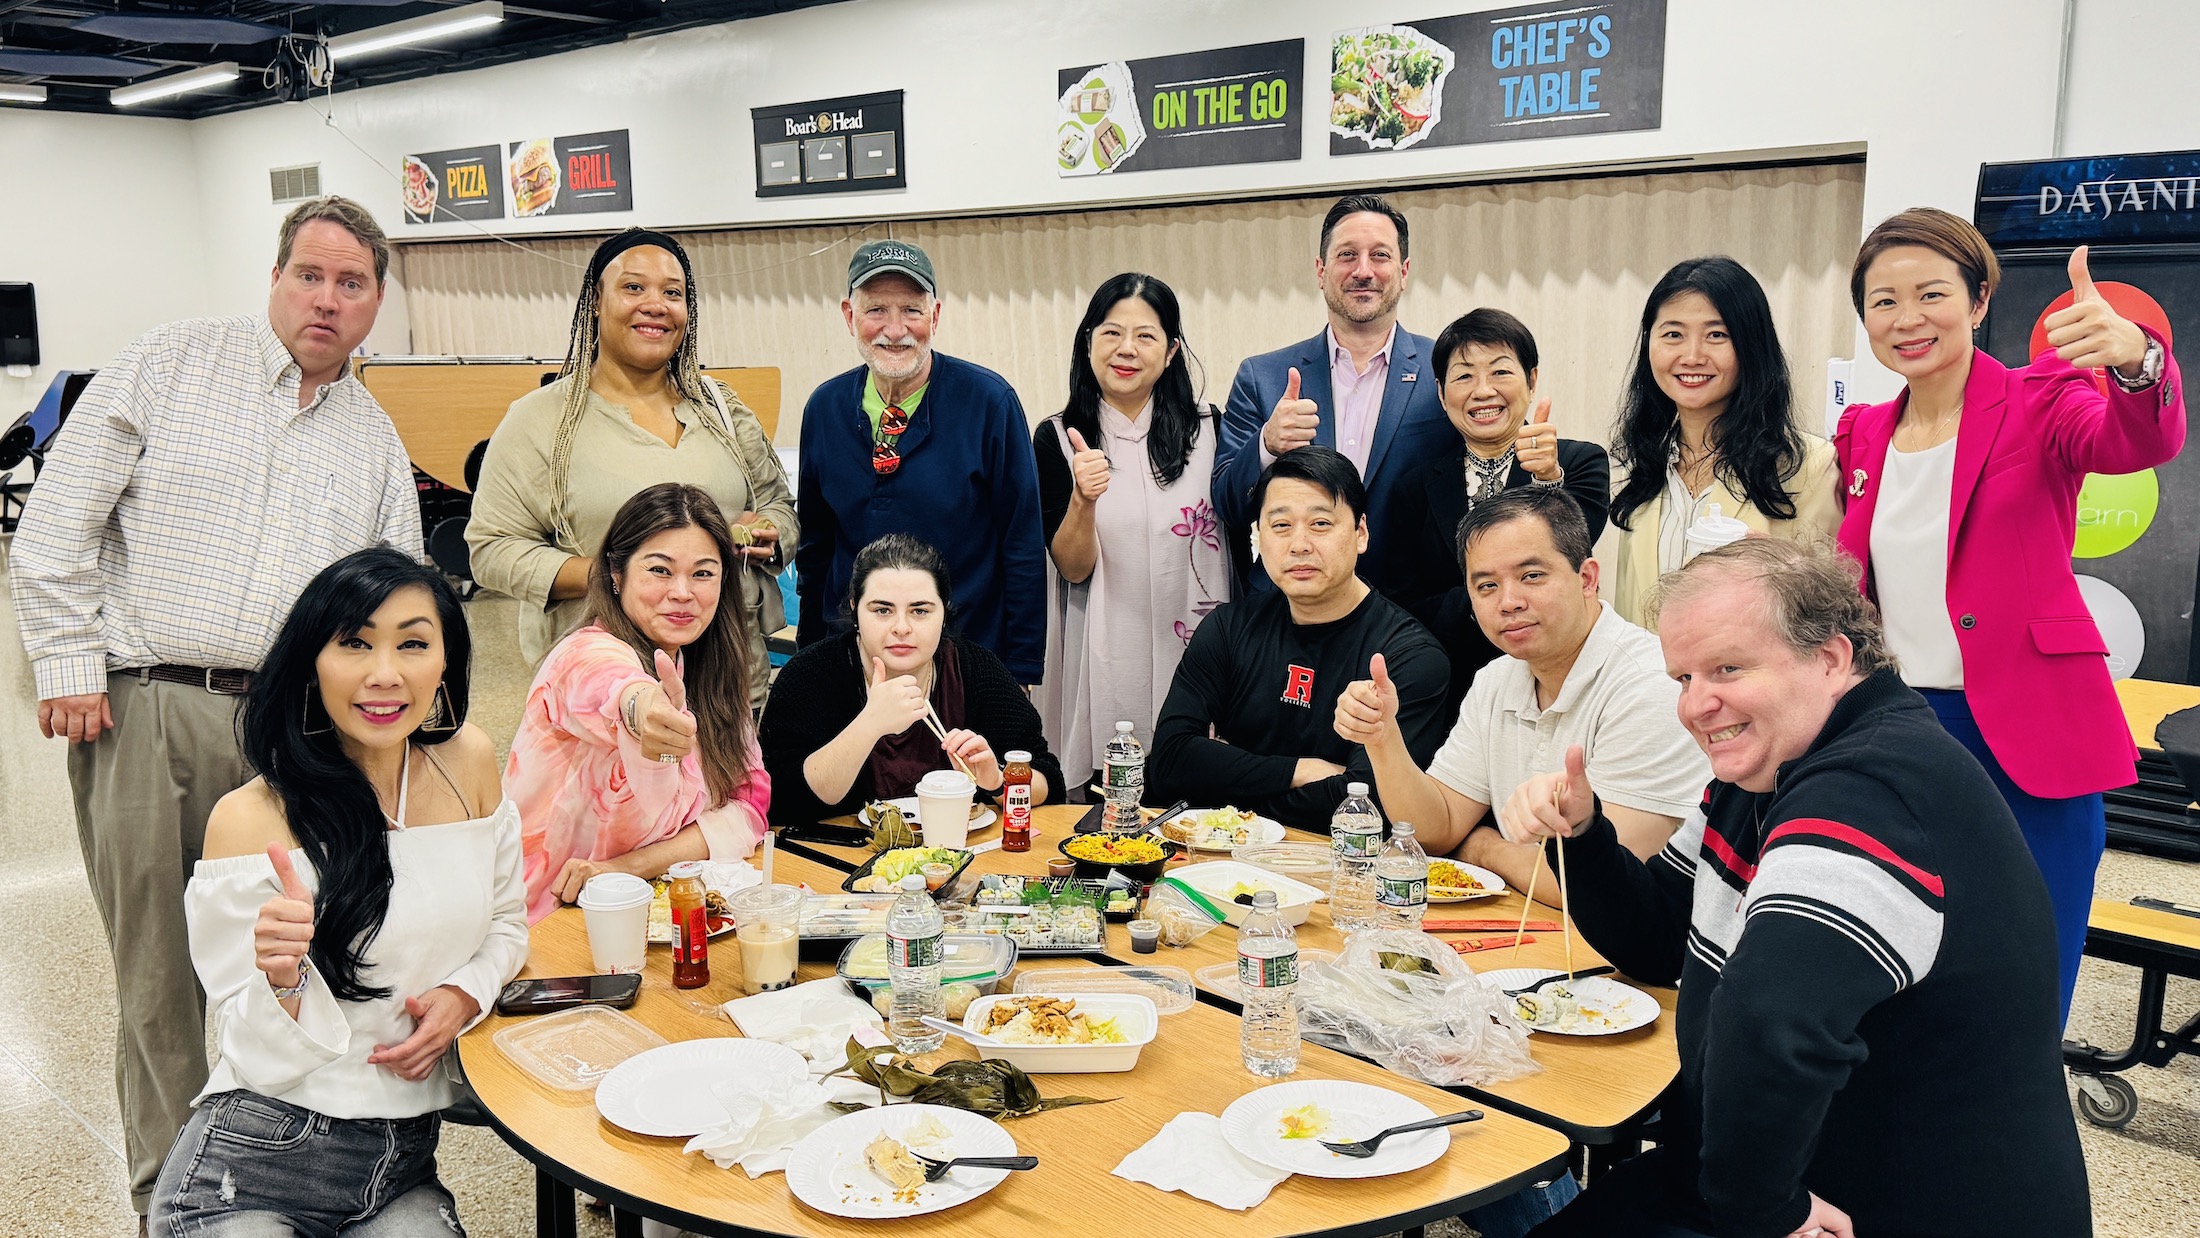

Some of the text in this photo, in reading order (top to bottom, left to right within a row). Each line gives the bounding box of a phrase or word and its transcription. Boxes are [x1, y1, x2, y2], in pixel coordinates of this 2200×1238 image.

[1491, 15, 1612, 70] CHEF'S
[1153, 79, 1287, 130] ON THE GO
[1499, 69, 1600, 117] TABLE
[785, 109, 863, 136] Boar's Head
[447, 165, 489, 198] PIZZA
[568, 153, 617, 191] GRILL
[2038, 173, 2198, 221] DASANI
[2077, 507, 2138, 527] arn
[1283, 664, 1315, 703] R
